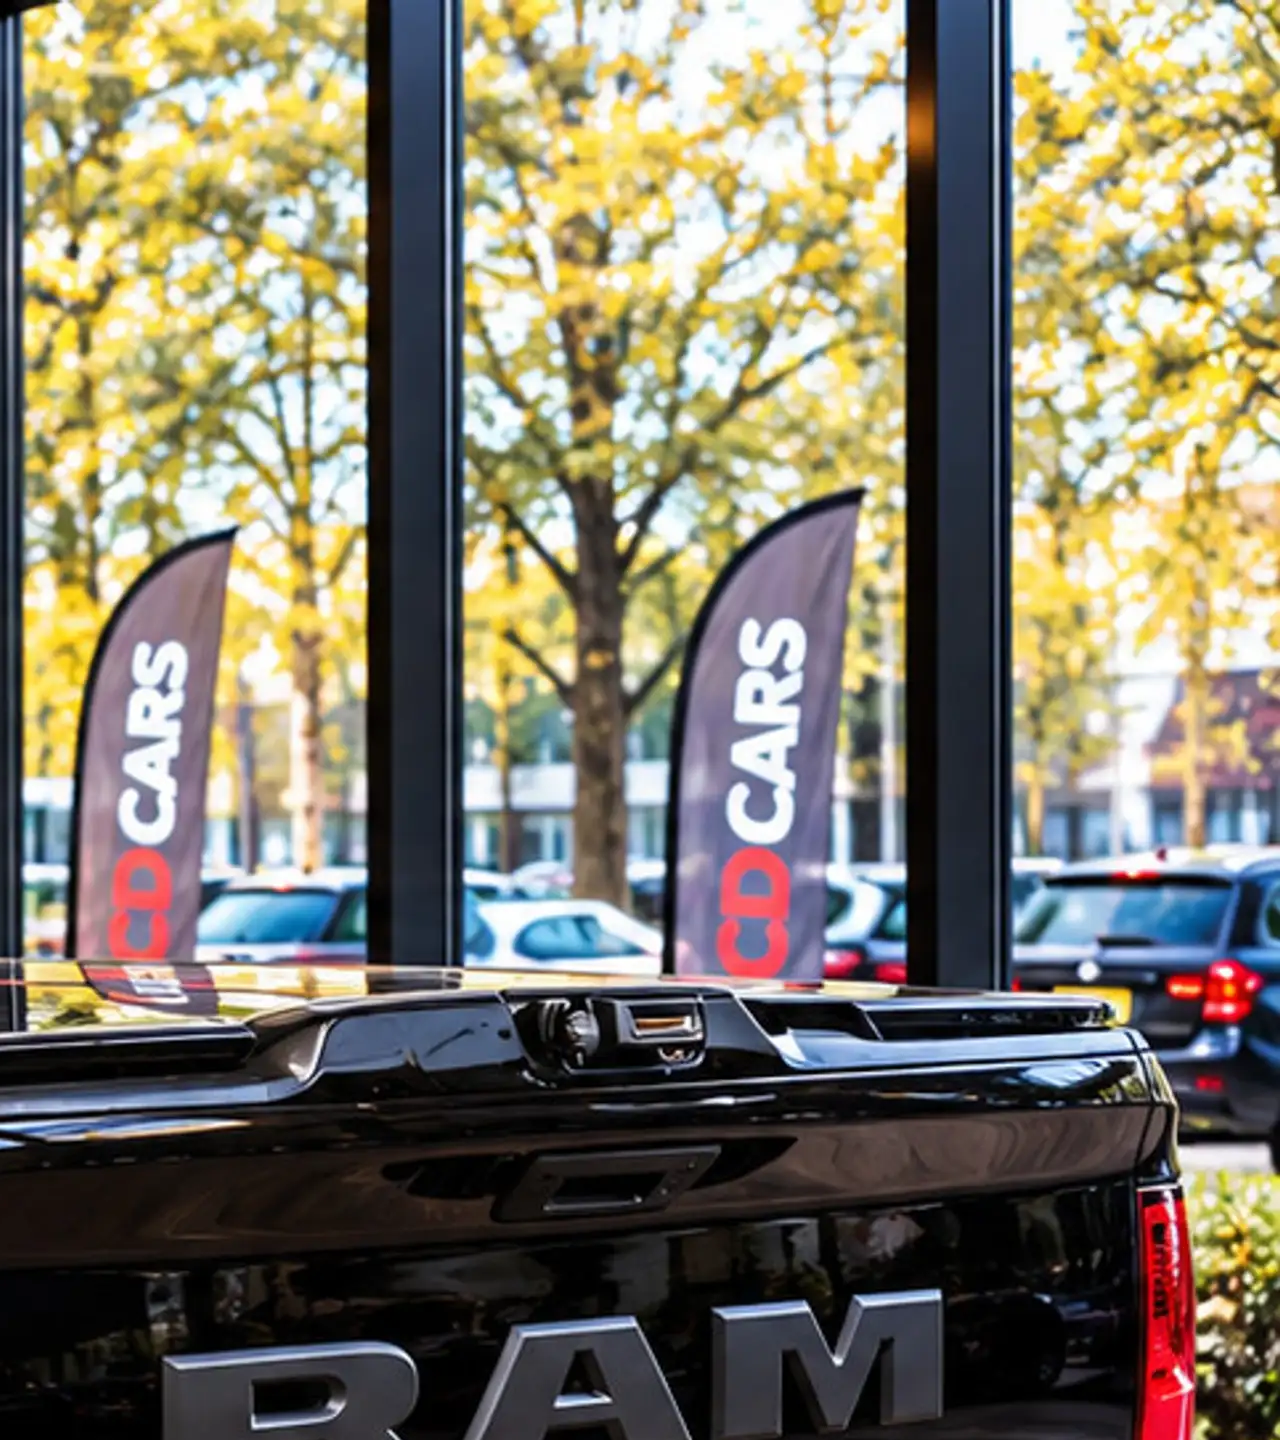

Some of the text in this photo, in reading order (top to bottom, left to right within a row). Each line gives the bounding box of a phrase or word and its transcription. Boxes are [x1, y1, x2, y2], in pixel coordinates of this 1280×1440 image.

[107, 640, 188, 959] CD CARS
[717, 617, 807, 978] CD CARS
